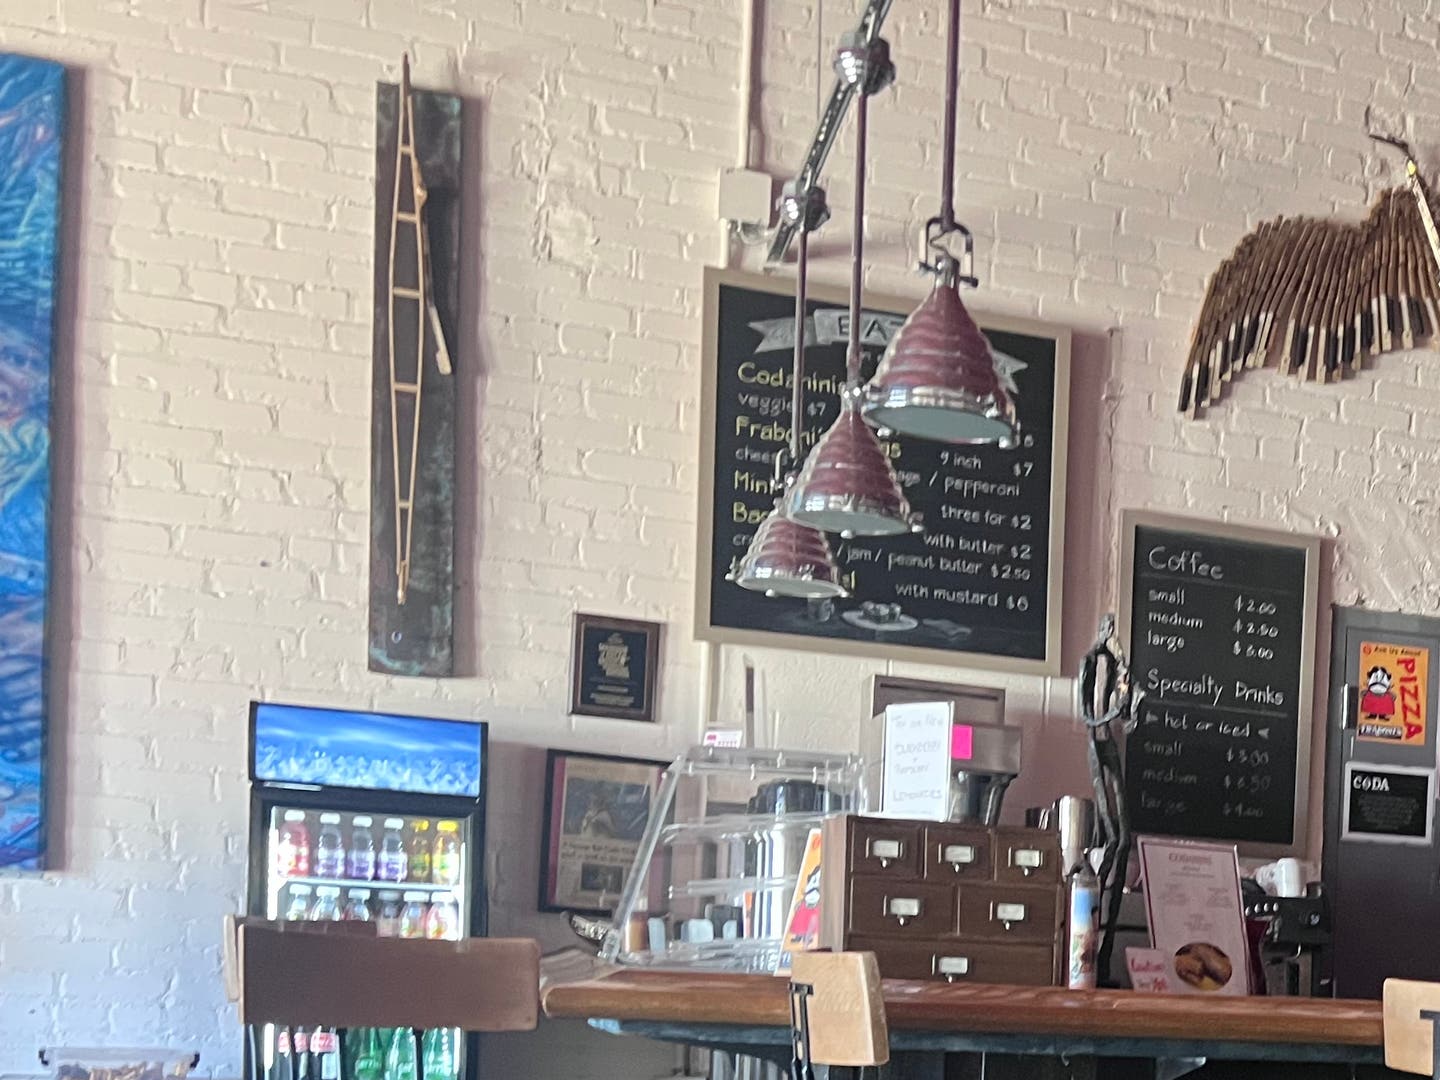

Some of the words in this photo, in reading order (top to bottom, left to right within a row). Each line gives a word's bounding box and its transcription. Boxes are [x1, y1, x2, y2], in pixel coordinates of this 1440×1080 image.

[953, 453, 982, 470] inch
[944, 475, 1020, 498] pepperoni
[941, 504, 981, 523] three
[985, 509, 1006, 526] for
[923, 533, 955, 550] with
[959, 535, 1004, 556] butter
[888, 552, 935, 571] peanut
[939, 556, 983, 576] butter
[1148, 546, 1224, 580] Coffee
[896, 582, 929, 600] with
[934, 587, 999, 608] mustard
[1149, 588, 1185, 606] small
[1149, 611, 1204, 629] medium
[1148, 630, 1185, 653] large
[1147, 668, 1224, 706] Specialty
[1235, 680, 1284, 706] Drinks
[1397, 657, 1423, 740] PIZZA
[1164, 710, 1188, 731] hot
[1196, 717, 1213, 731] or
[1352, 775, 1390, 792] CODA
